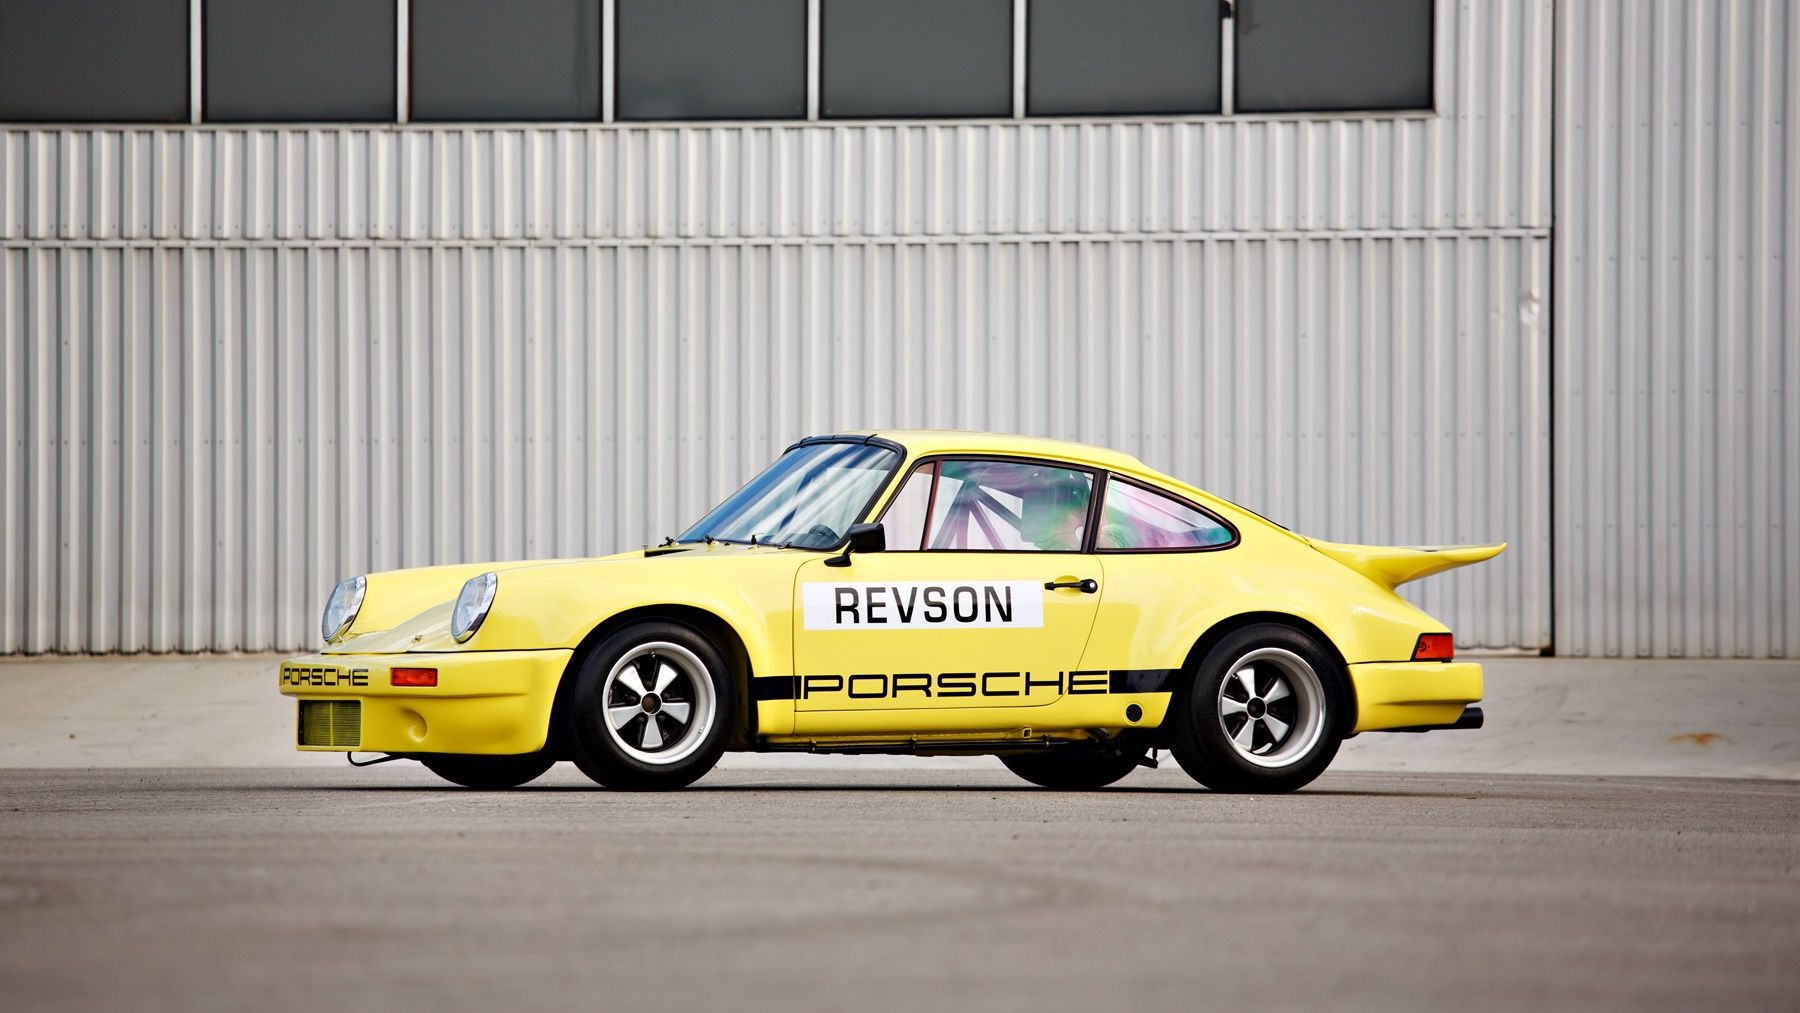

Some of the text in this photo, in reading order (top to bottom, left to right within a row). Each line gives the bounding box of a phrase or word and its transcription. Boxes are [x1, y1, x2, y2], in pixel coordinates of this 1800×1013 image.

[835, 585, 1013, 624] REVSON
[283, 668, 369, 686] PORSCHE
[803, 671, 1108, 699] PORSCHE
